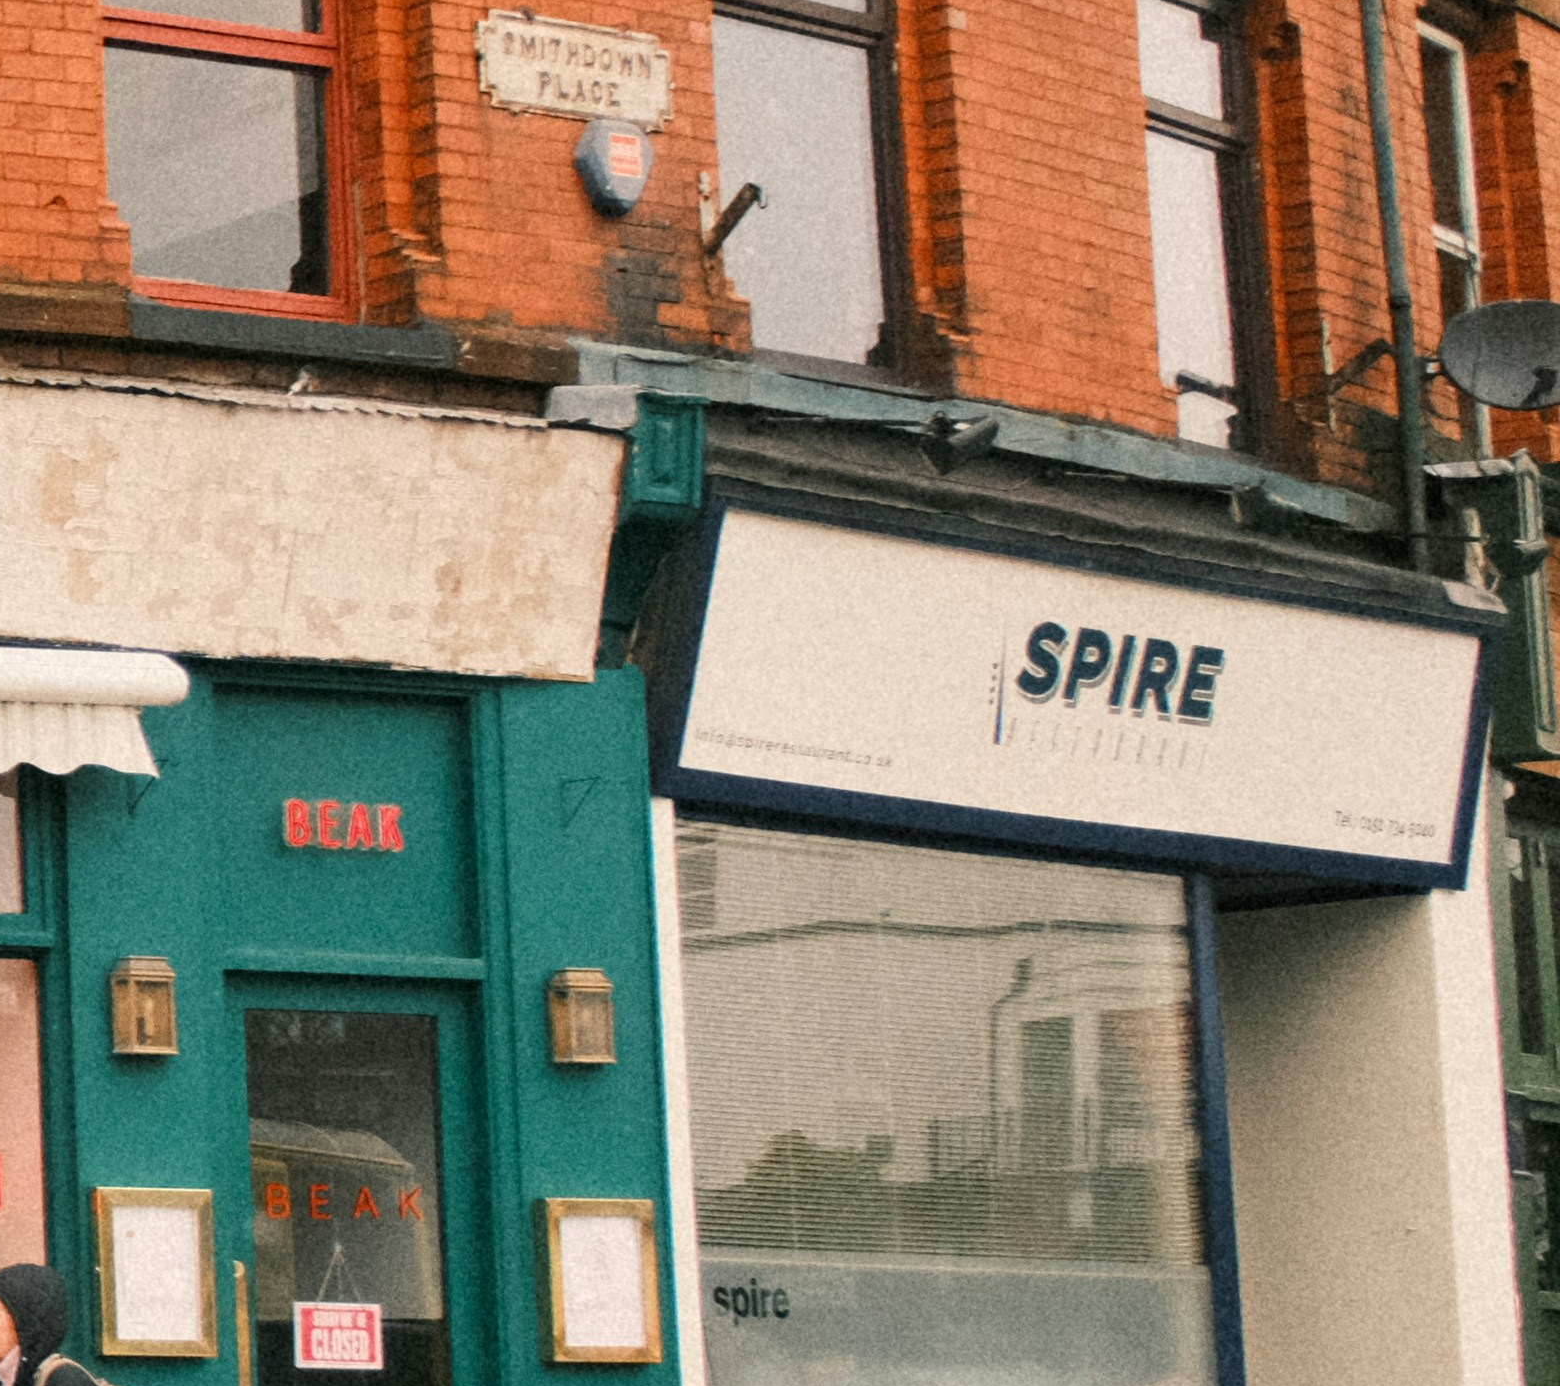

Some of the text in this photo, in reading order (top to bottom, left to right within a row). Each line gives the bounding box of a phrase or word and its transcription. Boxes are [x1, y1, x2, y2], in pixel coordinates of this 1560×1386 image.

[502, 31, 653, 81] SMITHDOWN
[537, 71, 620, 108] PLACE
[1015, 622, 1225, 726] SPIRE
[282, 797, 405, 852] BEAK
[263, 1180, 424, 1220] BEAK
[712, 1280, 790, 1325] spire
[311, 1328, 369, 1362] CLOSED
